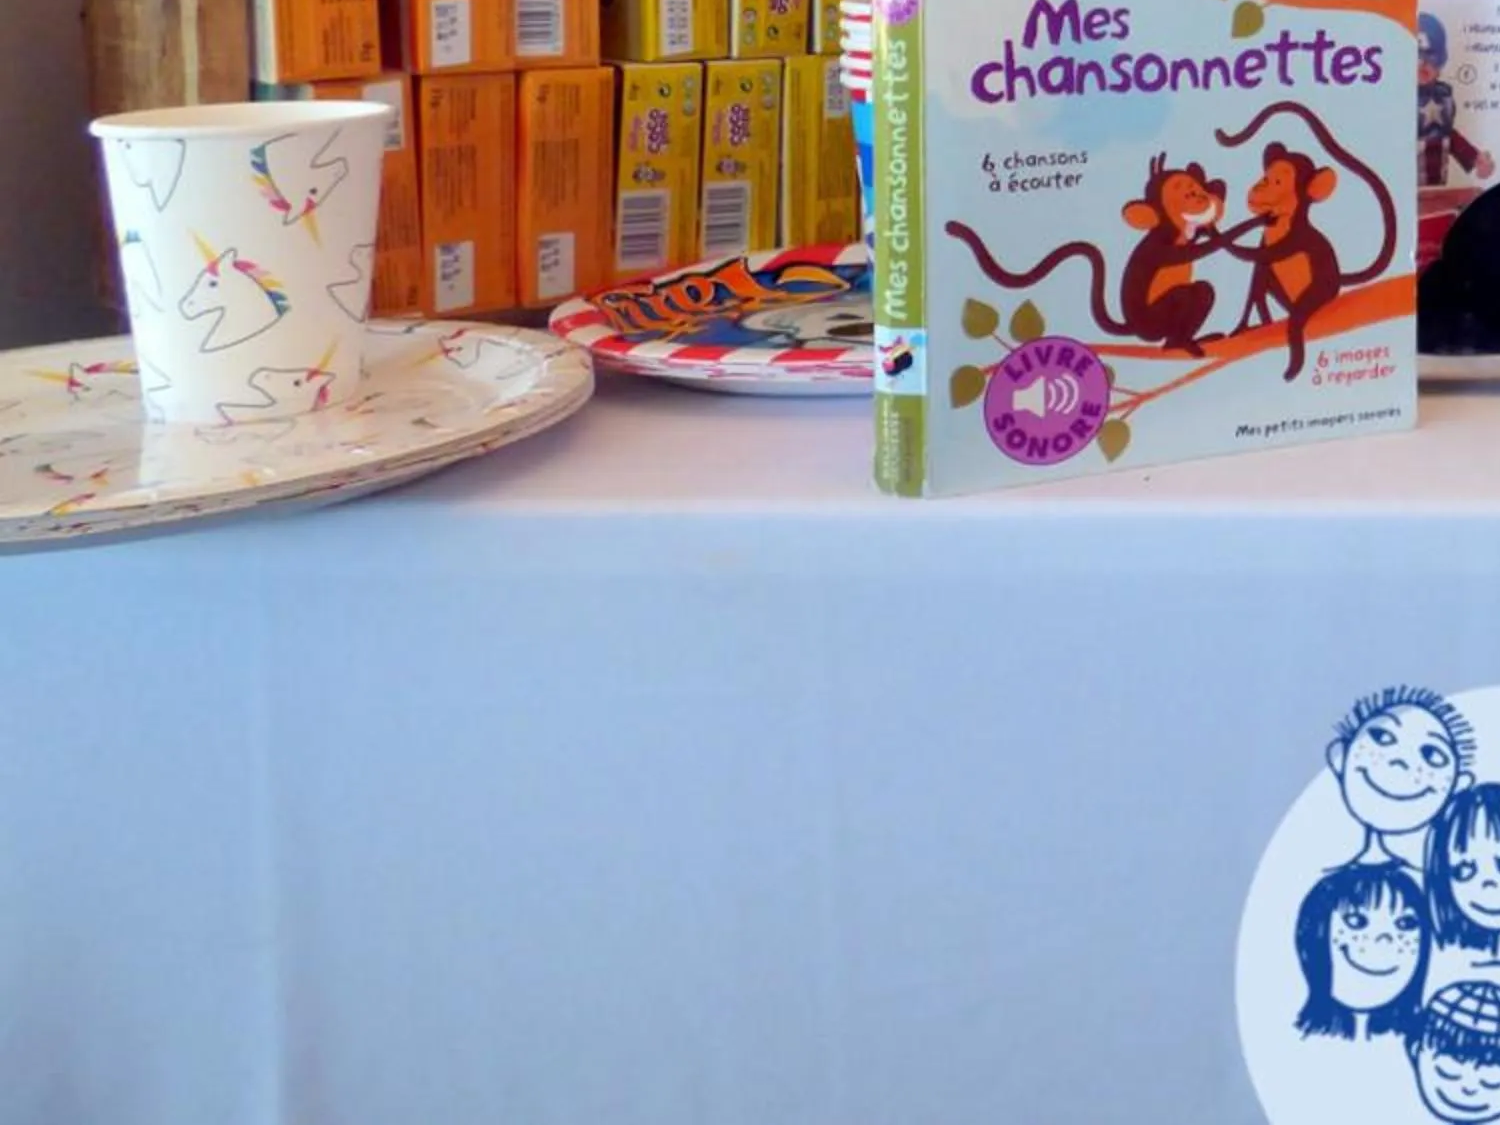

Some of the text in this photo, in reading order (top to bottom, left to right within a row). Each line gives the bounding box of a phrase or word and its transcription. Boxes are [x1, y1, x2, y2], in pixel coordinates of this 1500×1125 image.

[970, 29, 1383, 104] chansonnettes
[981, 149, 1089, 173] 6 chansons
[882, 38, 910, 320] Mes chansonnettes
[988, 171, 1083, 193] à écouter
[1003, 344, 1095, 383] LIVRE
[1317, 346, 1390, 369] 6 images
[1327, 363, 1397, 387] regarder
[992, 400, 1102, 459] SONORE
[1235, 424, 1262, 438] Mes
[1264, 418, 1304, 438] petits
